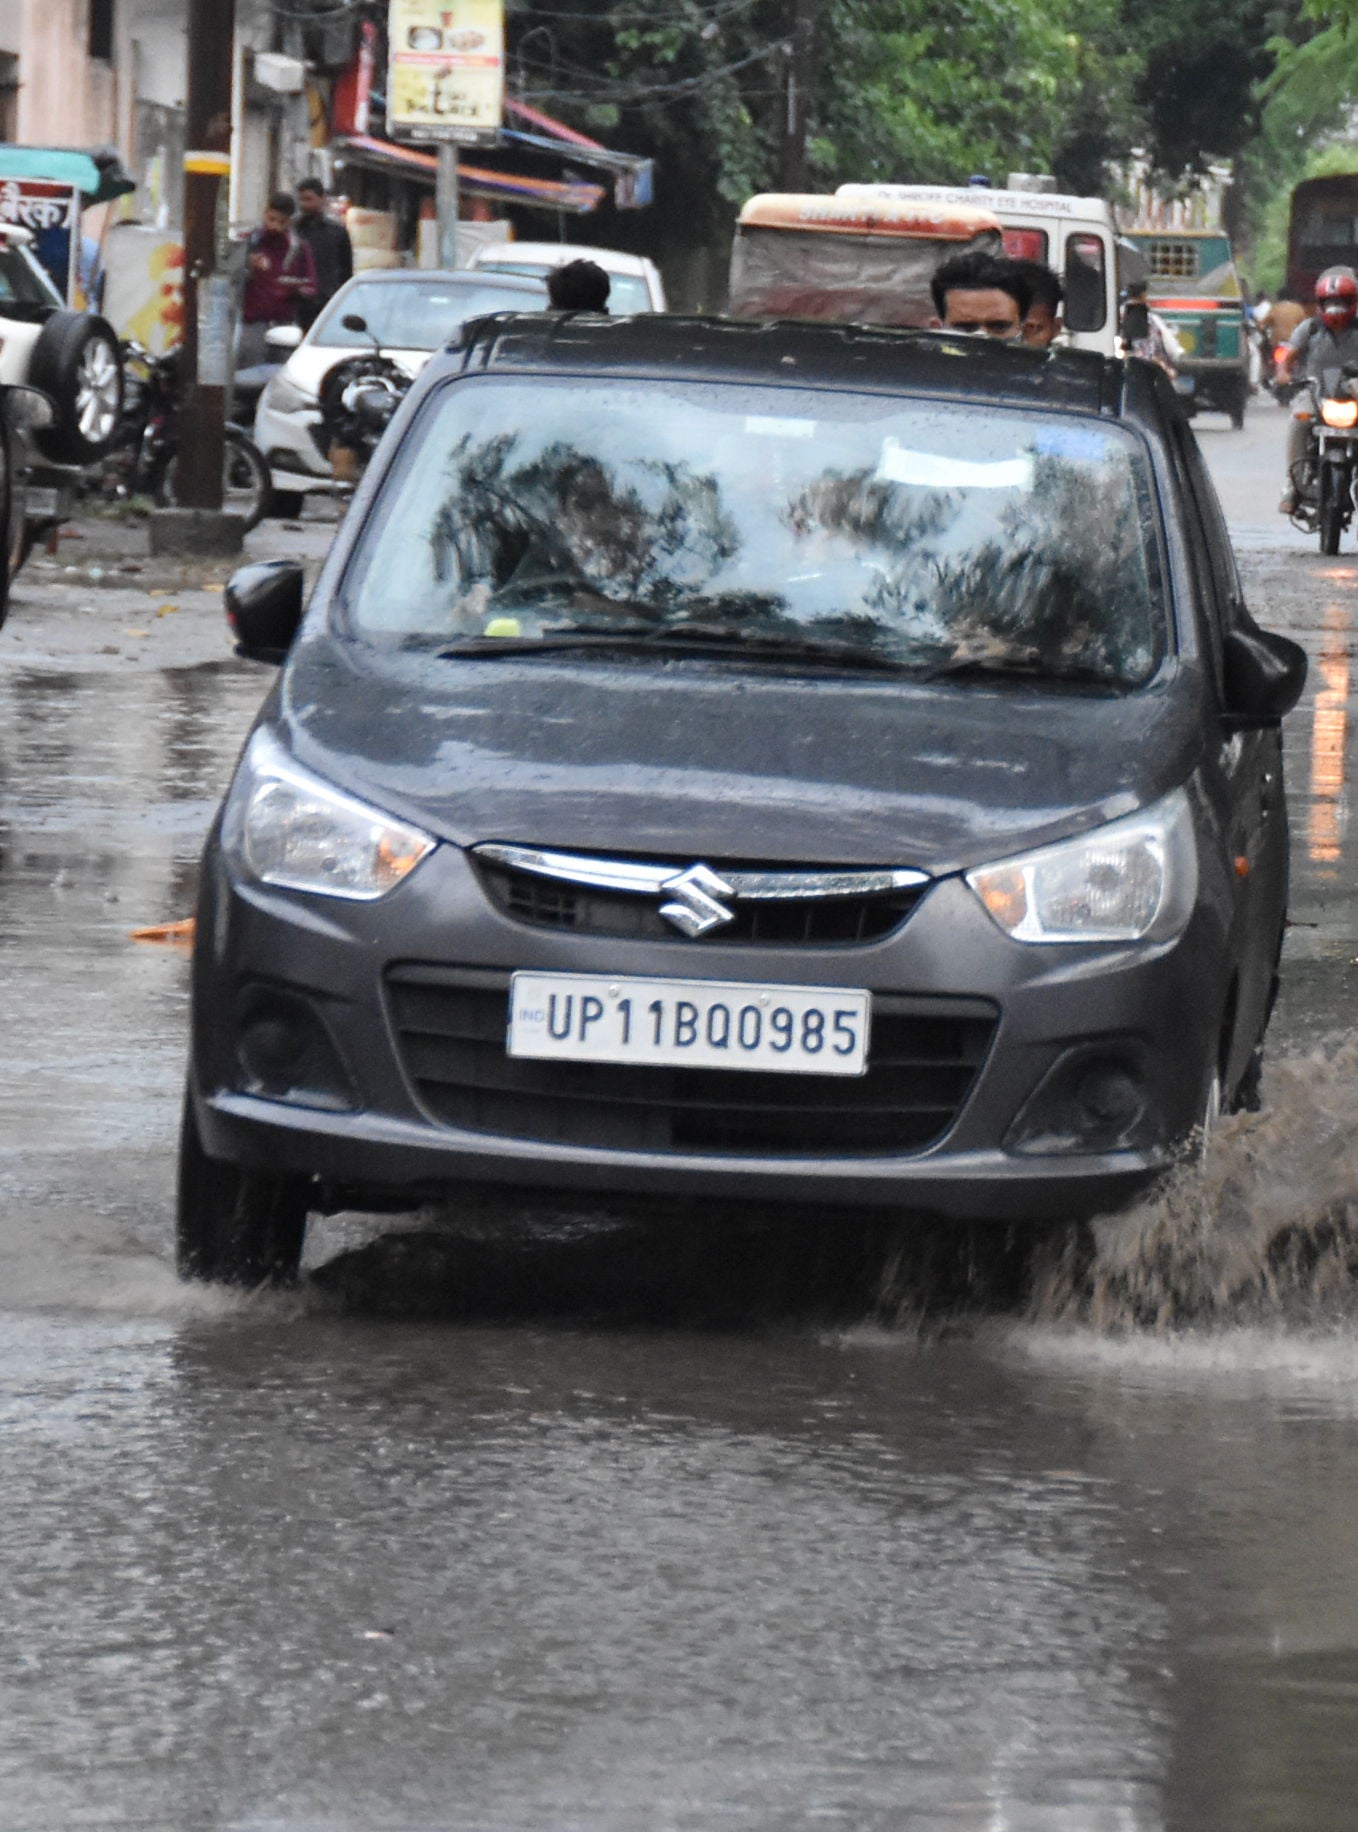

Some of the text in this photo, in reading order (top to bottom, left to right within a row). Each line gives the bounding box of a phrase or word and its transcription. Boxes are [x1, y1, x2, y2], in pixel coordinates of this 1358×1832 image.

[945, 193, 994, 206] CHARITY
[997, 196, 1016, 208] EYE
[1020, 198, 1072, 213] HOSPITAL
[519, 993, 858, 1056] IND UP11BQ0985
